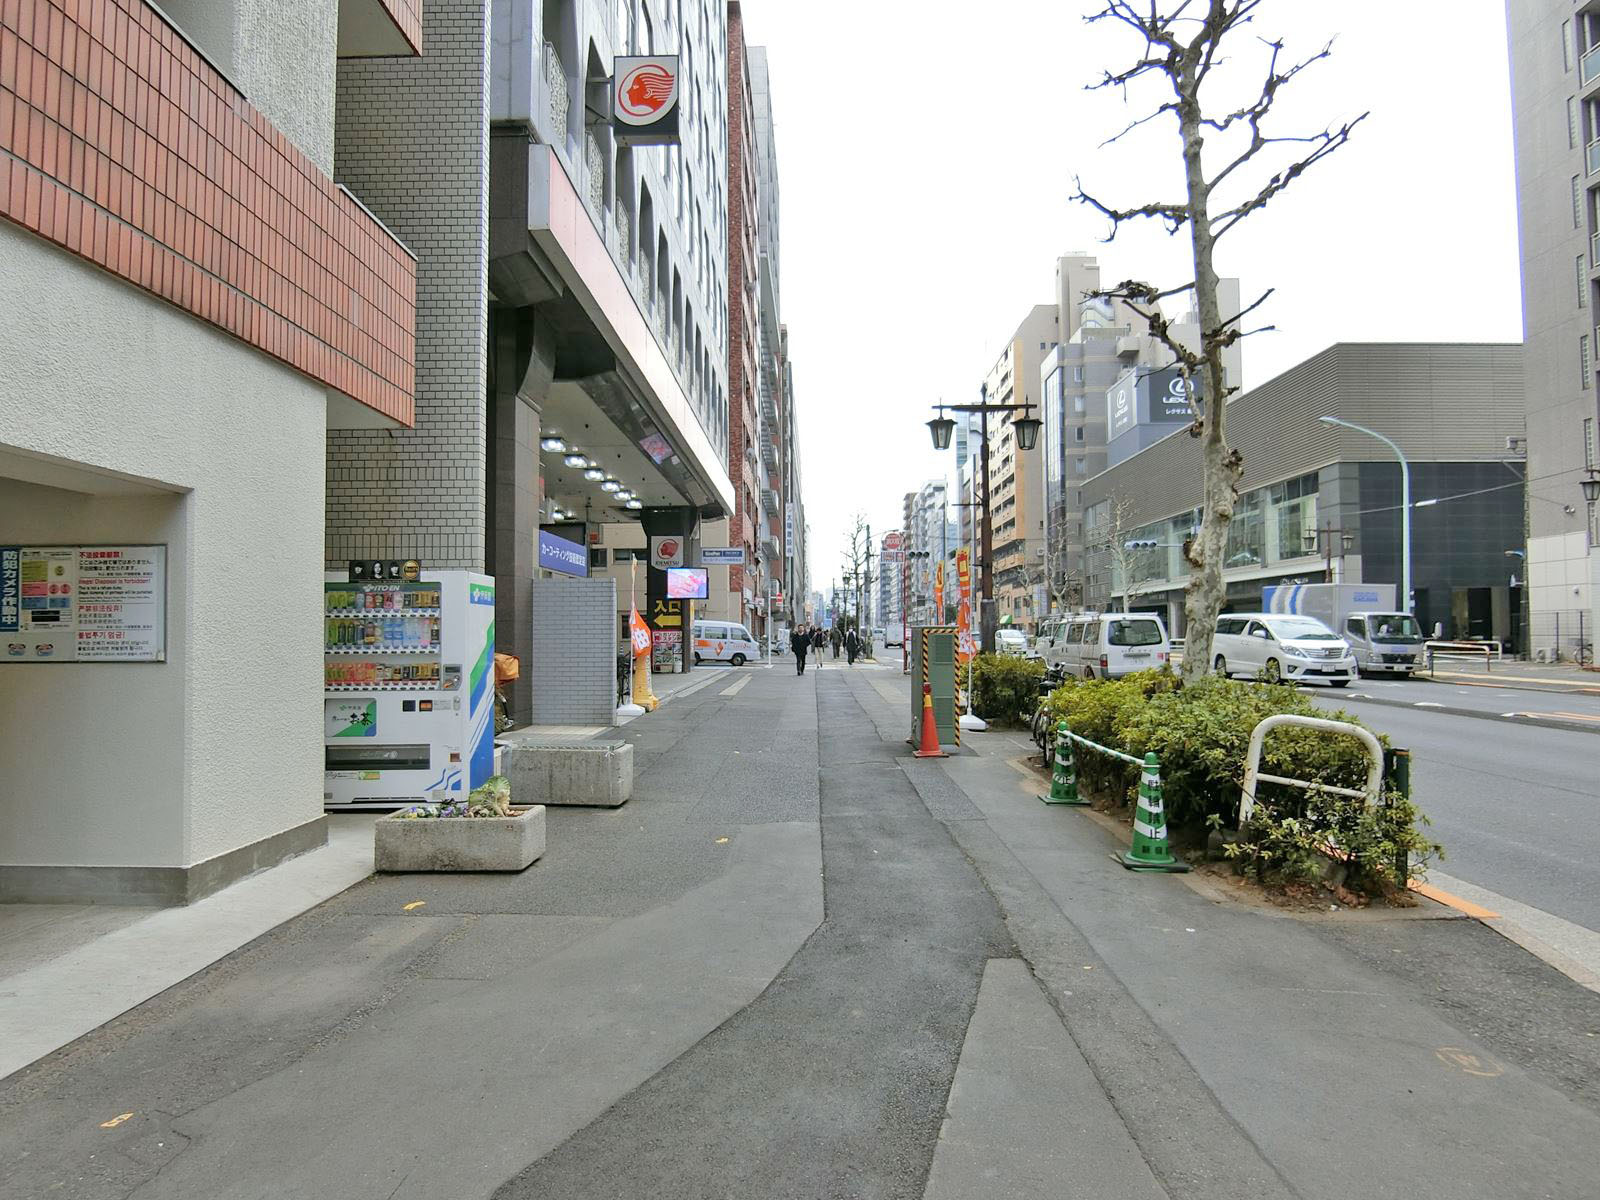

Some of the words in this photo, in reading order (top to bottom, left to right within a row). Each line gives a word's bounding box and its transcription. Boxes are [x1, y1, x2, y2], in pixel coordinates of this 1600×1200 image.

[654, 599, 681, 613] 入口
[1147, 779, 1161, 840] 駐輪禁止
